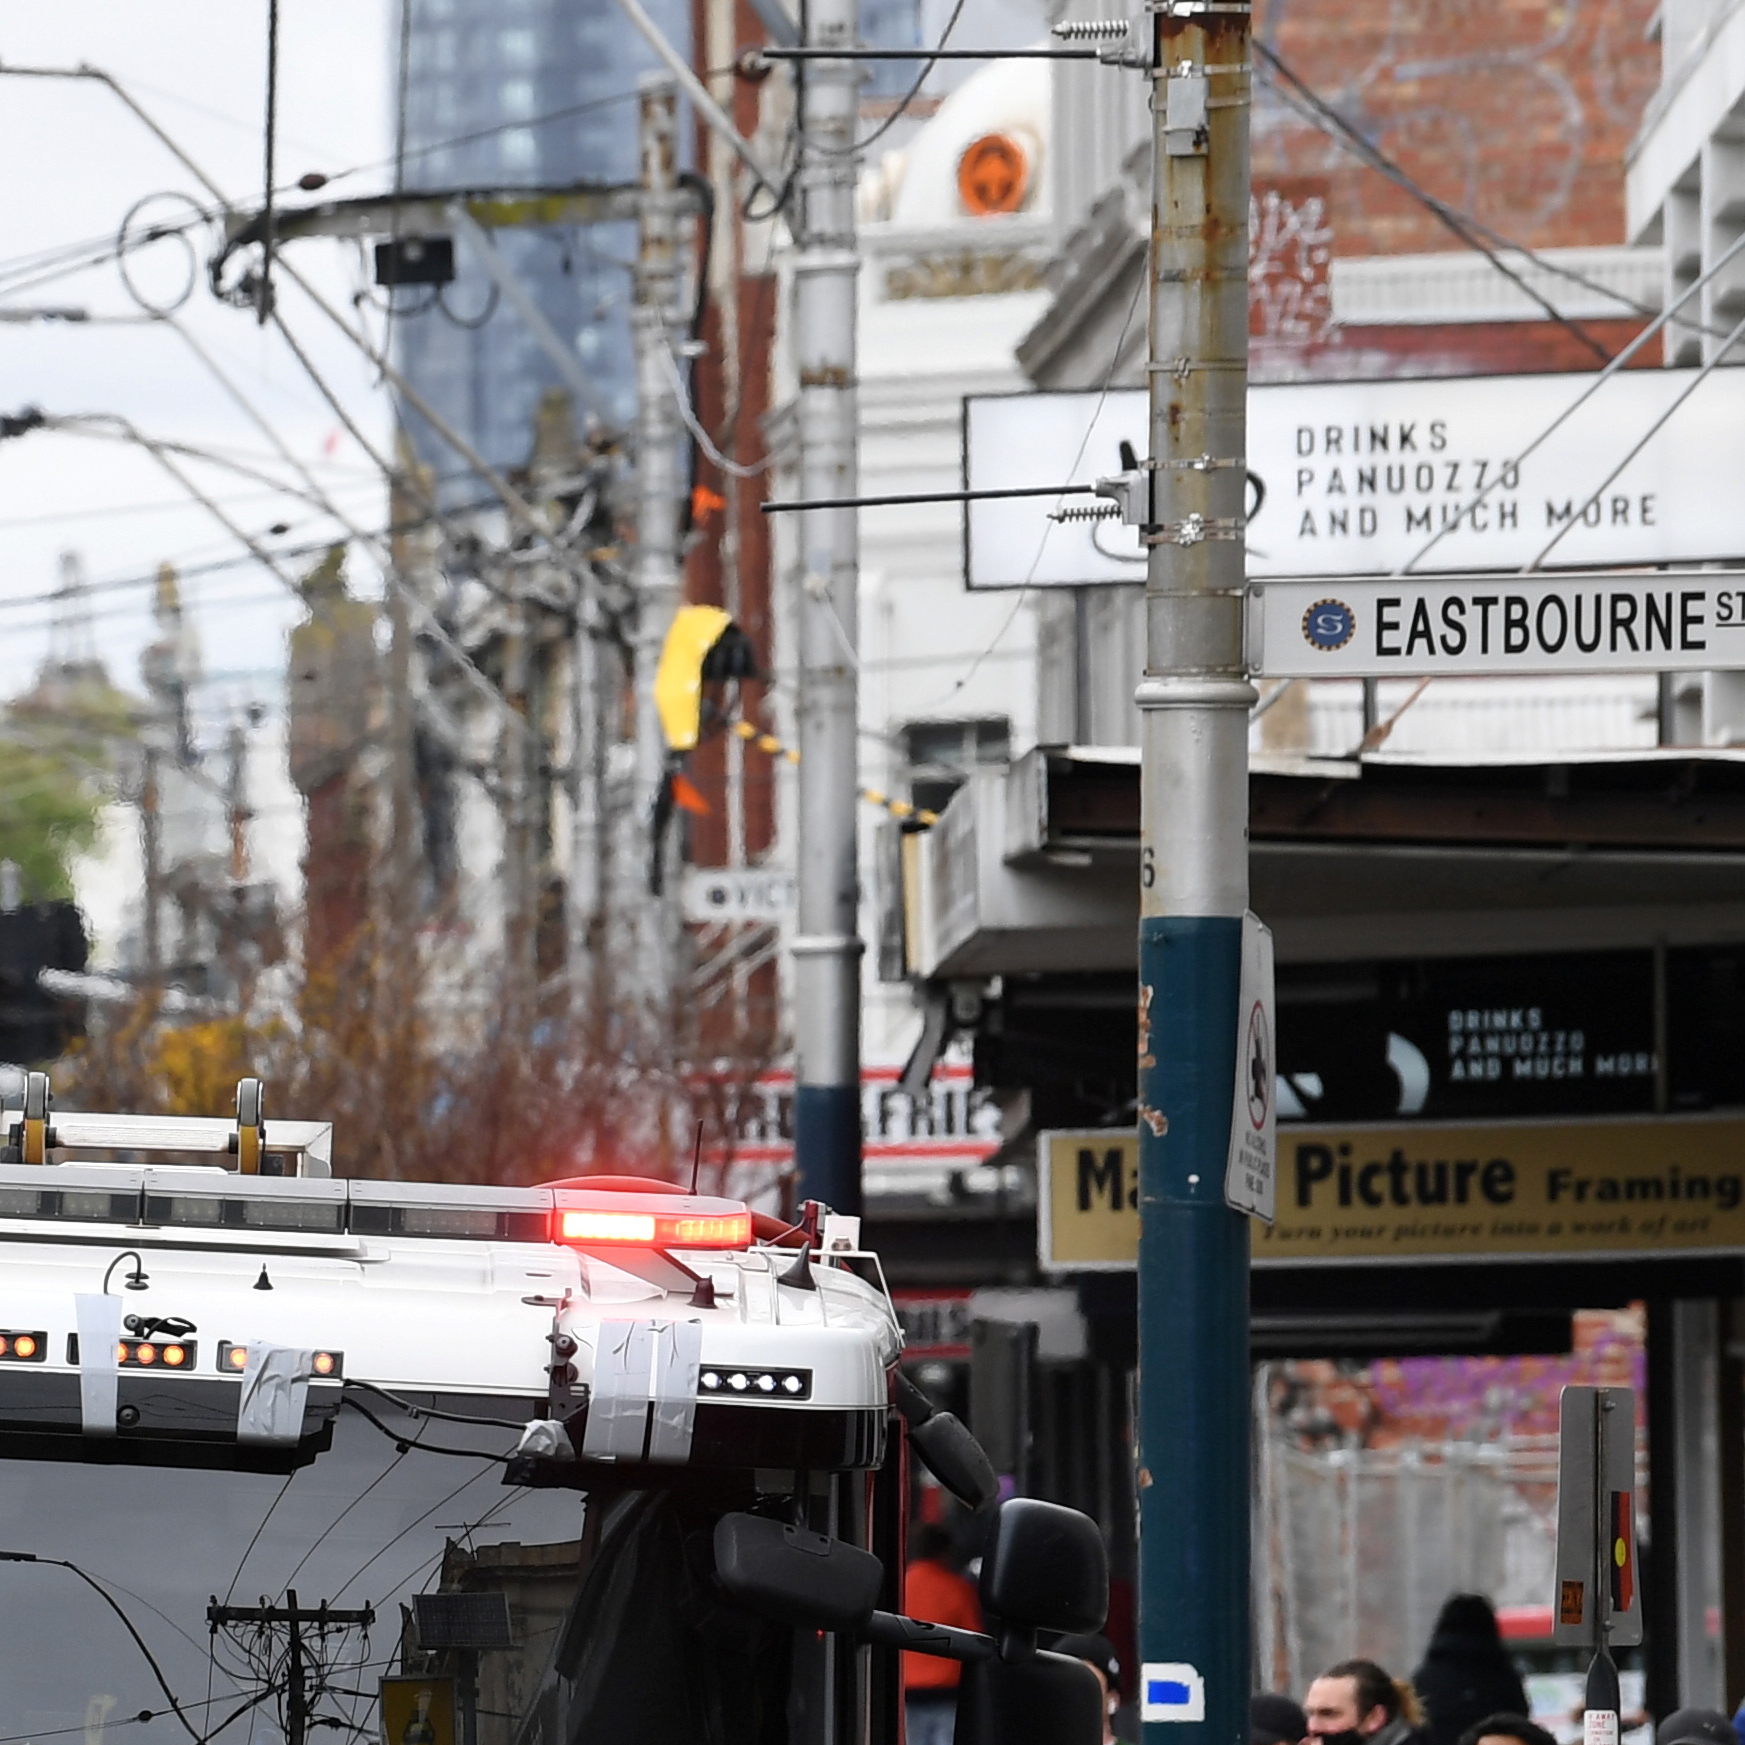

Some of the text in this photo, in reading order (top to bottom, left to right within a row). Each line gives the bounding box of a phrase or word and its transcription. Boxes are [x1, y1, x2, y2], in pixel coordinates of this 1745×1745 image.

[1297, 422, 1448, 456] DRINKS
[1297, 460, 1520, 497] PANUOZZO
[1298, 493, 1658, 538] AND MUCH MORE
[1375, 591, 1706, 657] EASTBOURNE
[1448, 1007, 1542, 1030] DRINKS
[1451, 1057, 1502, 1080] AND
[1513, 1055, 1584, 1079] MUCH
[1295, 1142, 1516, 1209] Picture
[1546, 1167, 1742, 1211] Framing
[1329, 1222, 1386, 1244] your
[1394, 1217, 1483, 1242] picture
[1490, 1218, 1539, 1236] into
[1571, 1215, 1632, 1234] work
[1638, 1214, 1668, 1238] of
[1672, 1214, 1710, 1233] art
